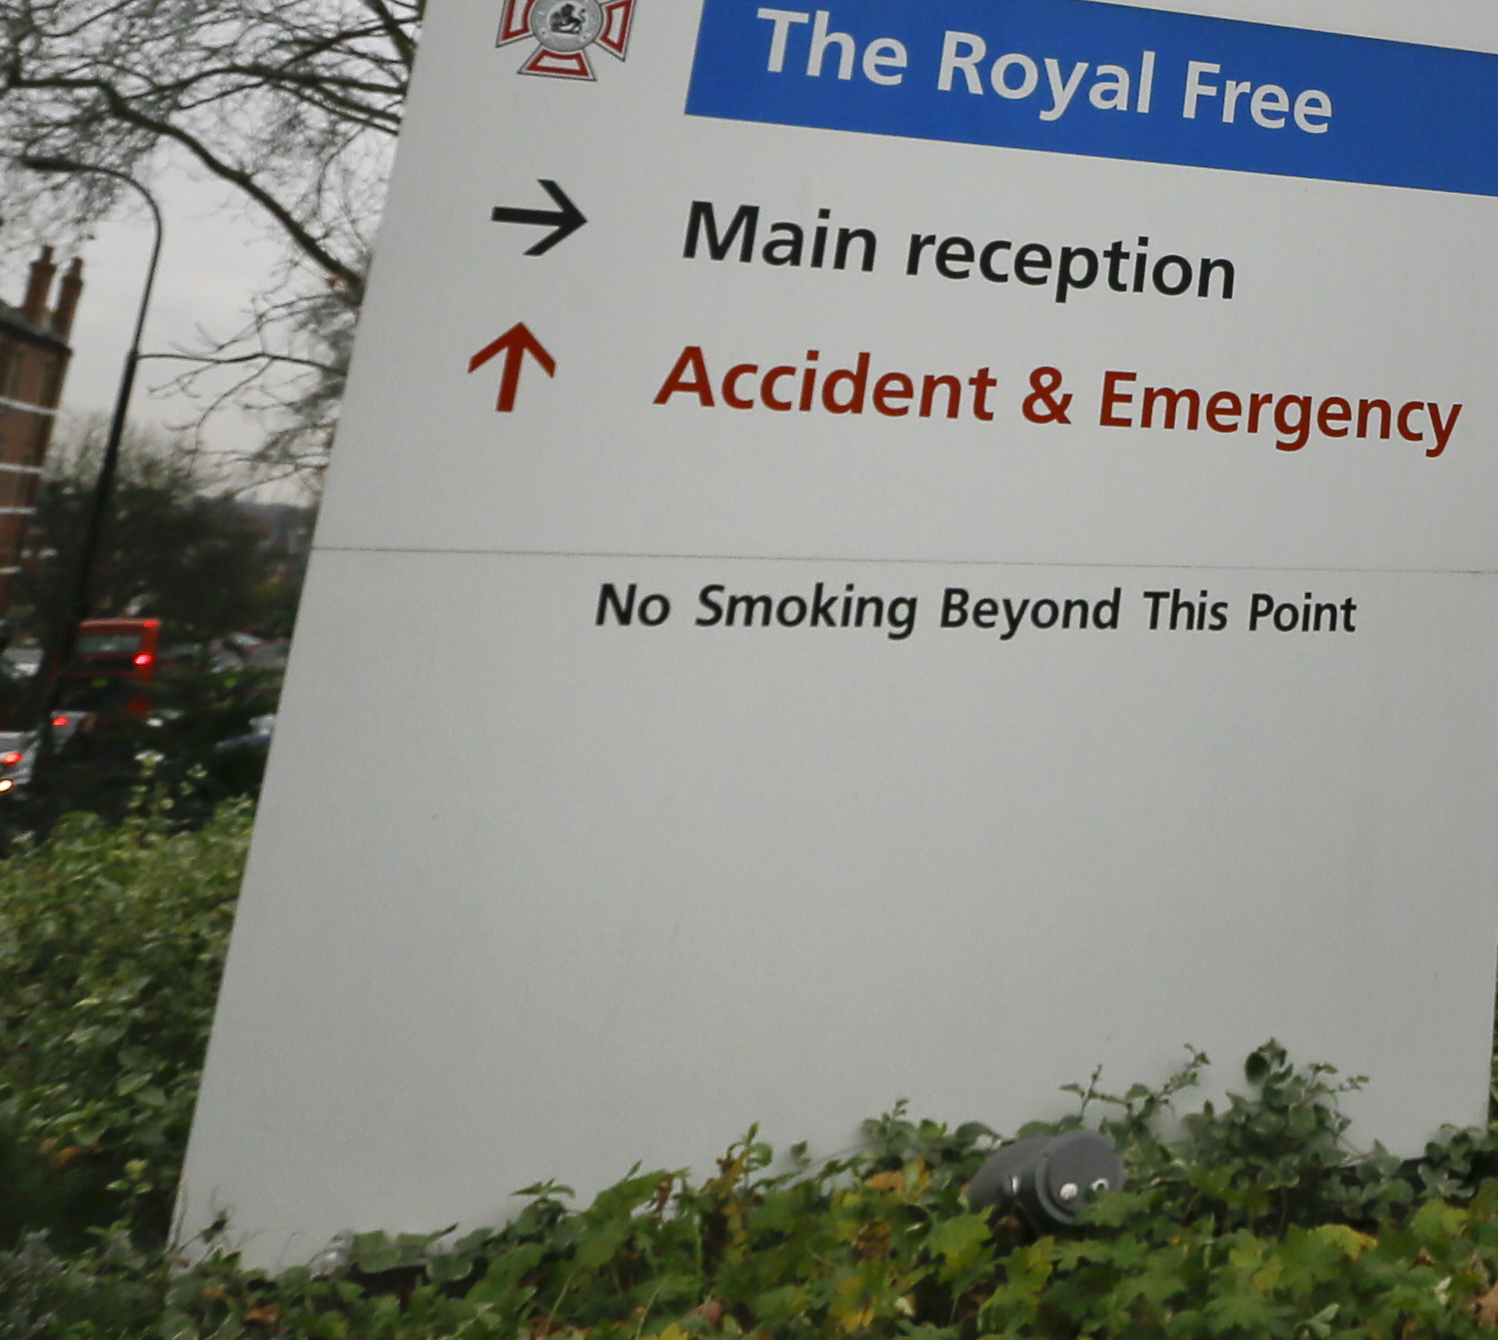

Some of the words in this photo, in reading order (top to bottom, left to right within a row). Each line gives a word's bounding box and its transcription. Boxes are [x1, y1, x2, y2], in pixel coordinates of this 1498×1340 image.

[756, 7, 908, 86] The
[937, 30, 1156, 122] Royal
[1182, 60, 1332, 134] Free
[682, 200, 877, 273] Main
[905, 233, 1235, 304] reception
[652, 345, 998, 422] Accident
[1021, 365, 1074, 425] &
[1098, 370, 1464, 459] Emergency
[594, 582, 672, 628] No
[694, 581, 918, 641] Smoking
[939, 586, 1122, 642] Beyond
[1142, 587, 1229, 632] This
[1248, 591, 1358, 633] Point
